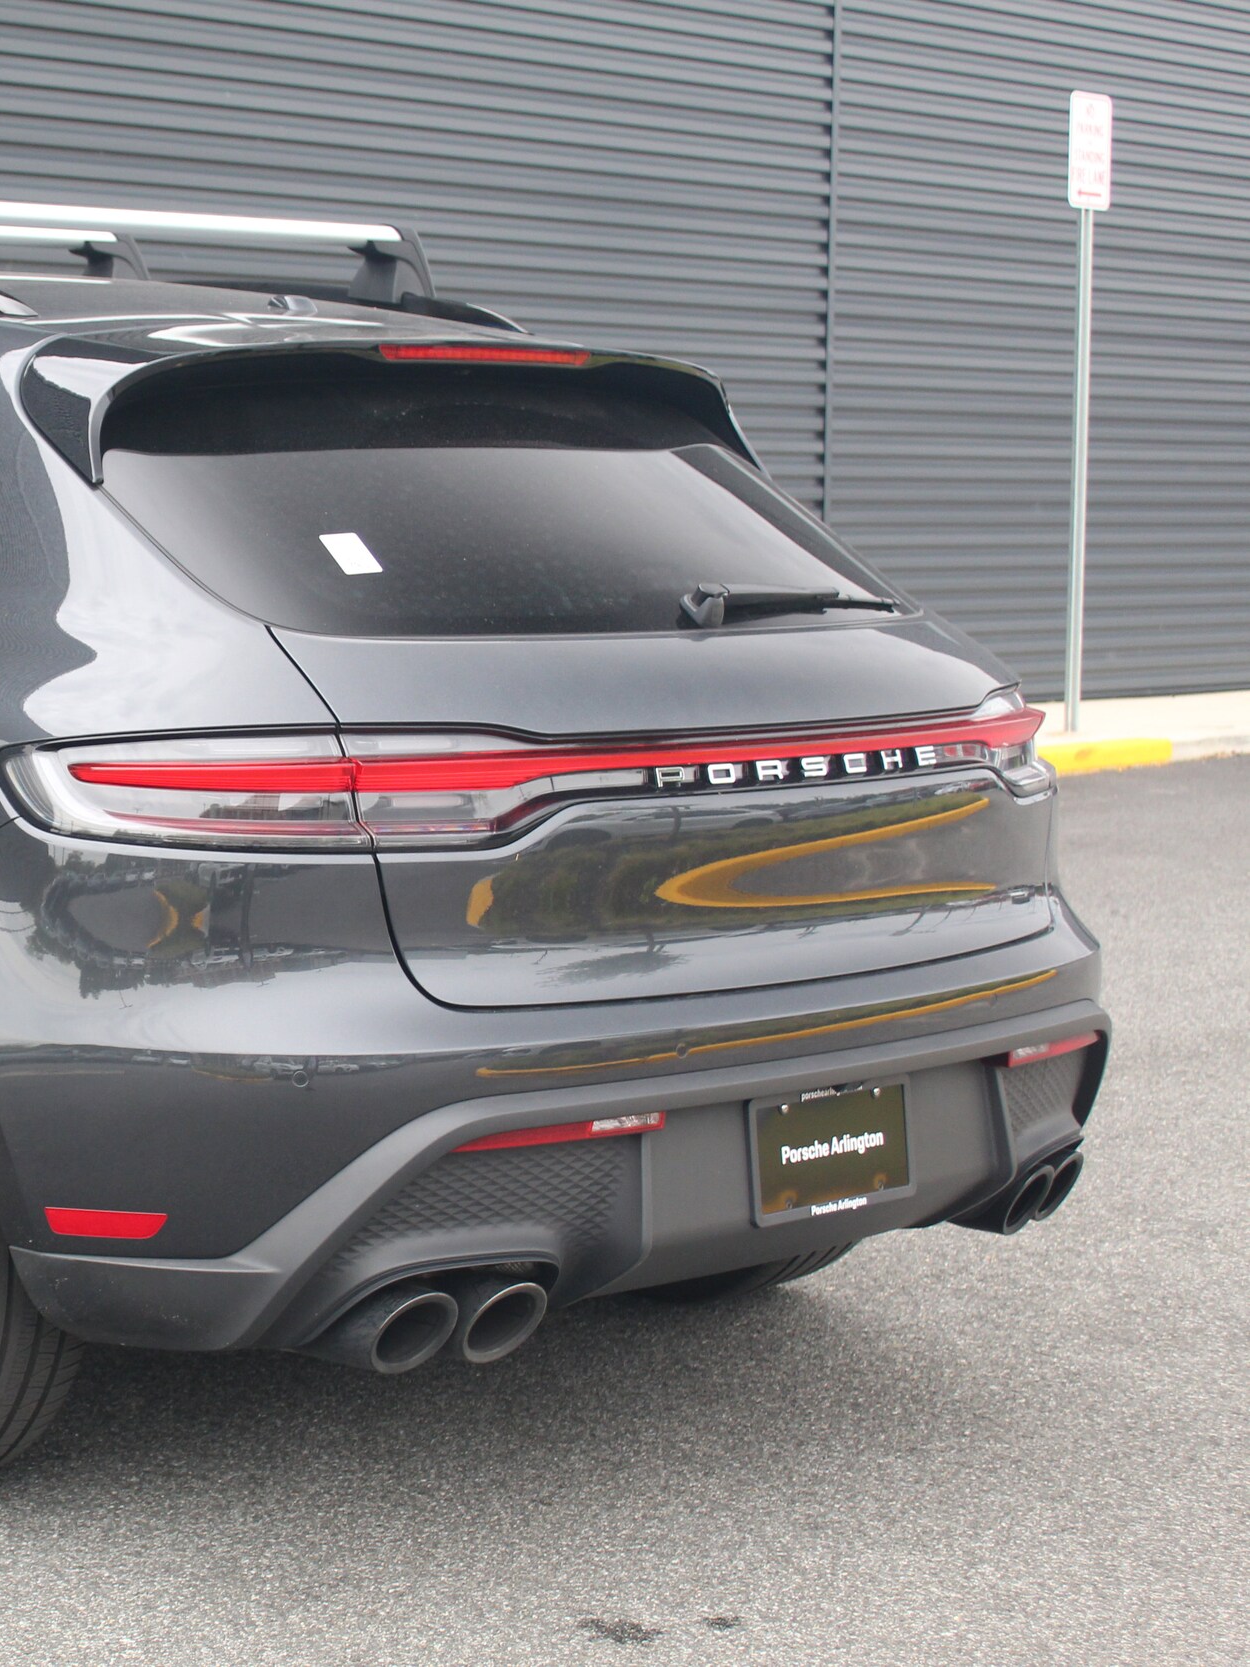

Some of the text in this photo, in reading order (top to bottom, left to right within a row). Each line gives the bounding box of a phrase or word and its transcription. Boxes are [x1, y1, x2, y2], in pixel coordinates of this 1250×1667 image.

[656, 745, 937, 788] PORSCHE
[781, 1131, 884, 1165] Porsche Arlington
[811, 1196, 867, 1216] Porsche Arlington
